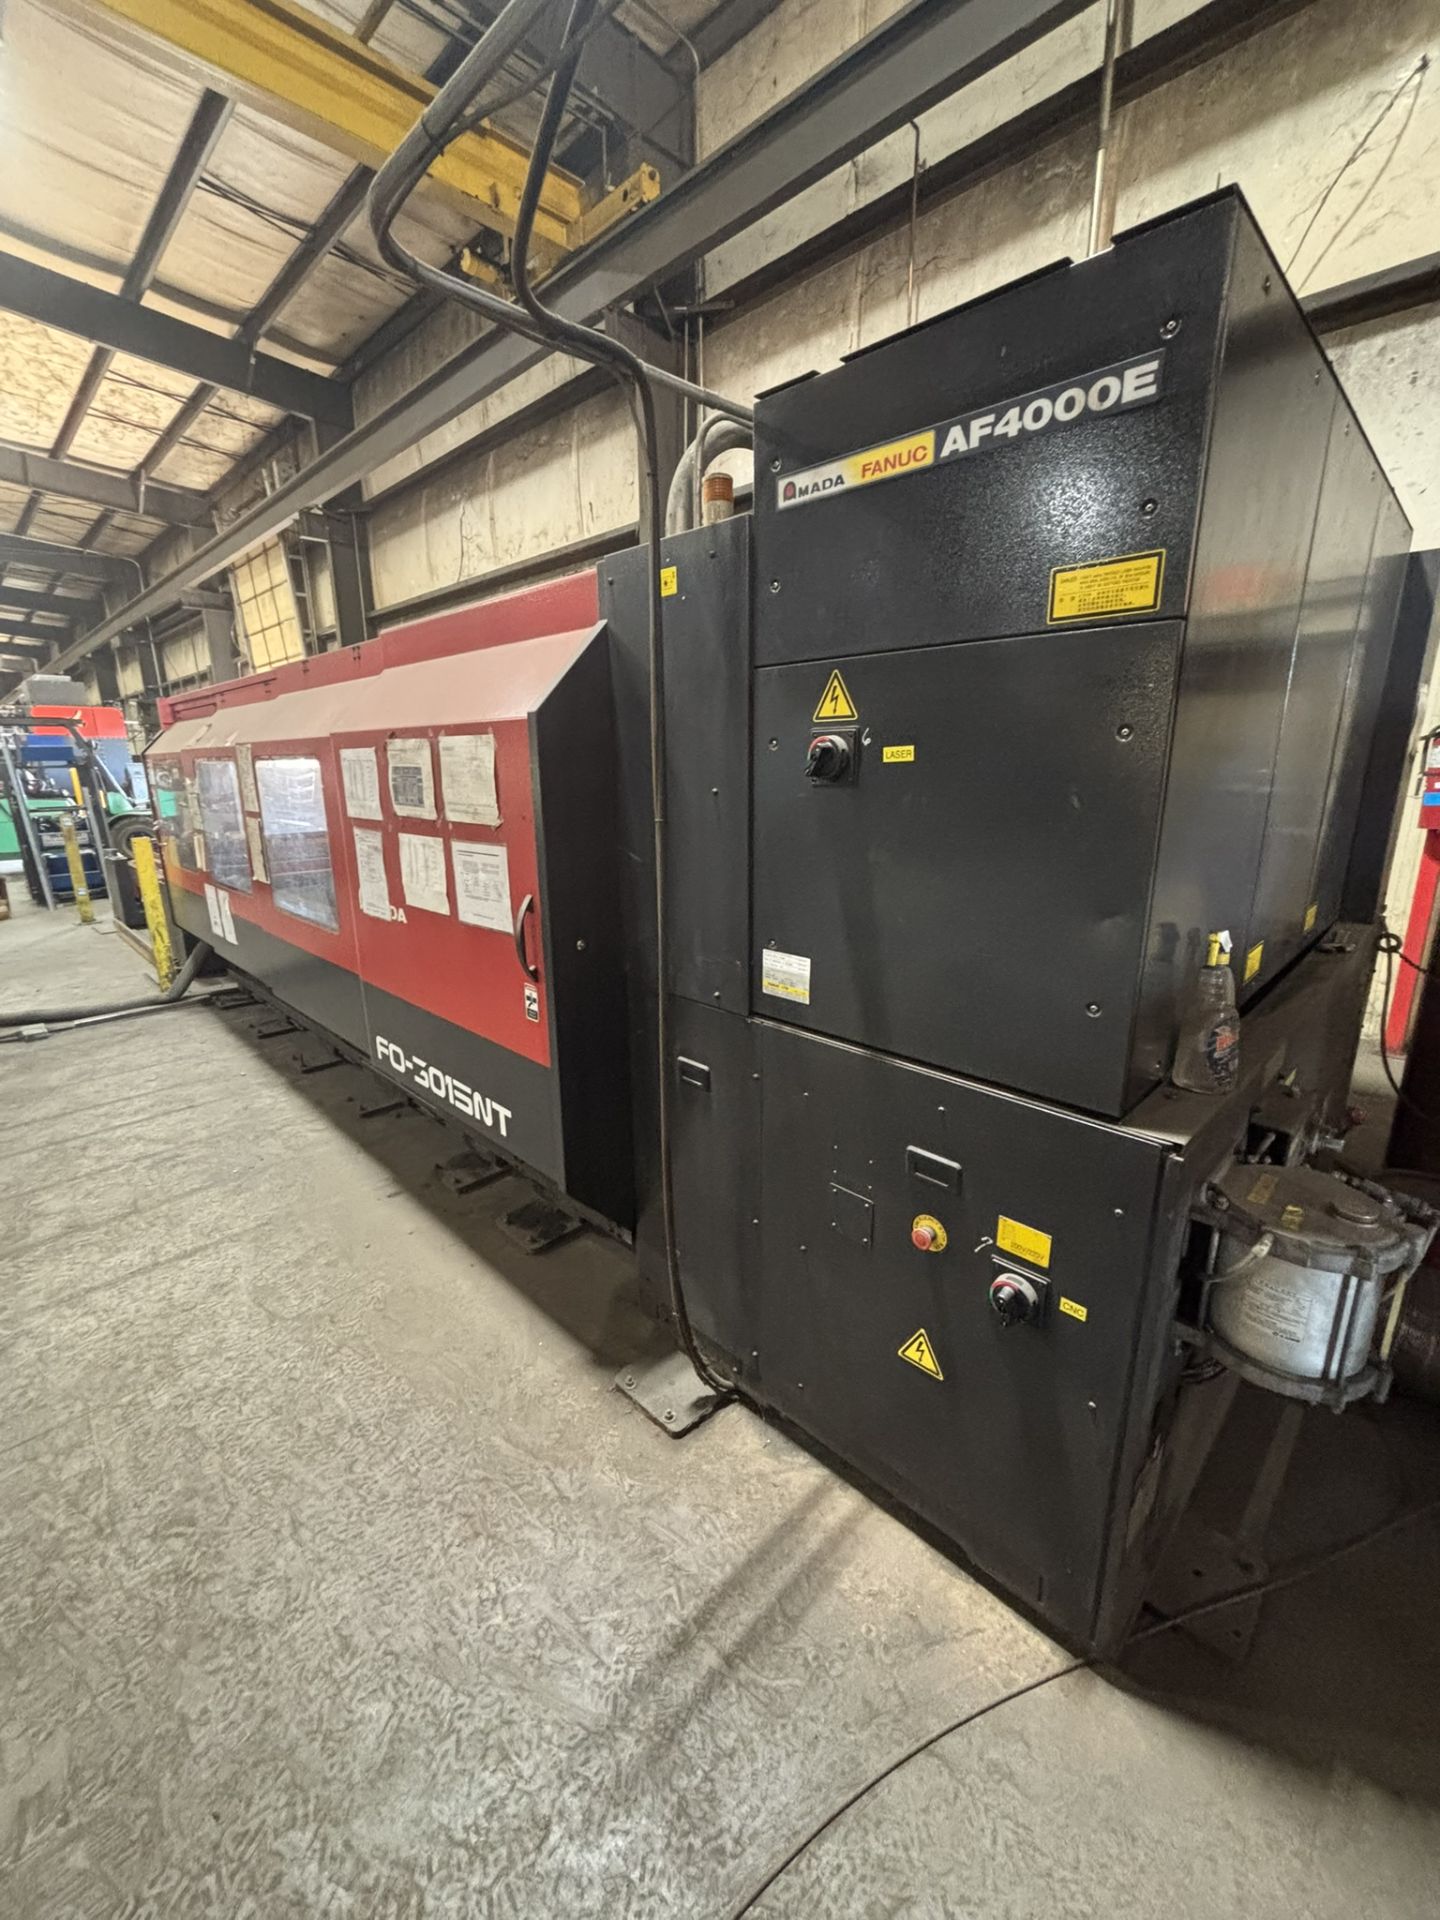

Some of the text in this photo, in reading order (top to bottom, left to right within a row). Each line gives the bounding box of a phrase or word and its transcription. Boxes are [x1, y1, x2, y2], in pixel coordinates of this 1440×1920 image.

[783, 359, 1160, 503] AMADA FANUC AF4000E
[885, 749, 913, 760] LASER
[375, 1035, 513, 1138] FO-3015NT
[1062, 1302, 1085, 1318] CNC
